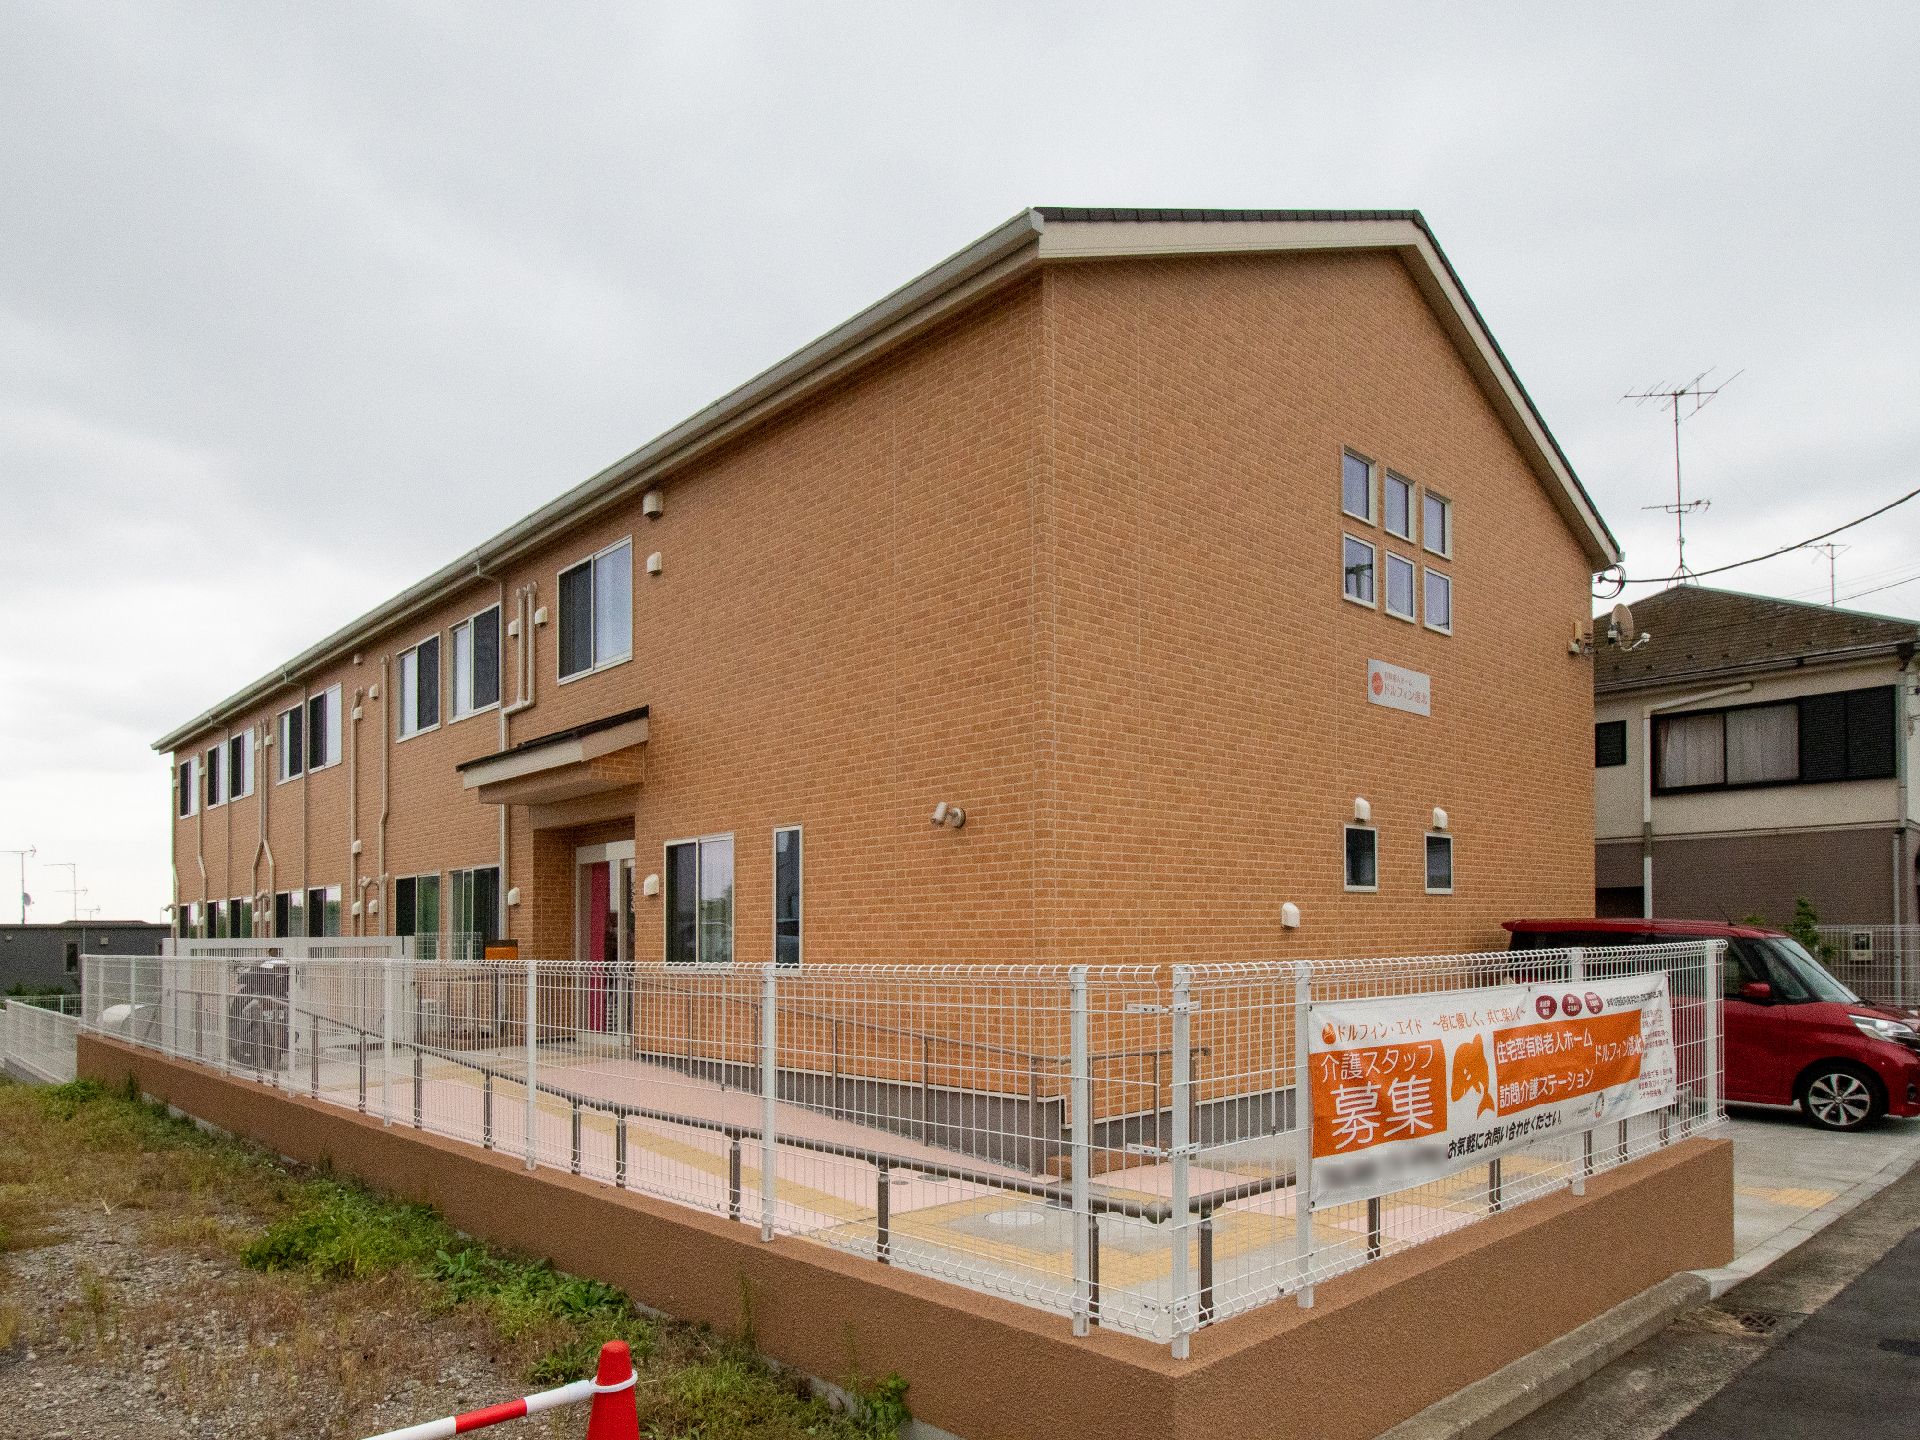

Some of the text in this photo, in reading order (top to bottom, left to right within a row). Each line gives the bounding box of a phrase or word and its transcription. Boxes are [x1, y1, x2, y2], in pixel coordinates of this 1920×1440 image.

[1320, 1044, 1434, 1083] 介護スタッフ
[1496, 1029, 1593, 1065] 住宅型有料老人ホーム
[1499, 1068, 1594, 1108] 訪問介護ステーション
[1331, 1075, 1434, 1150] 募集
